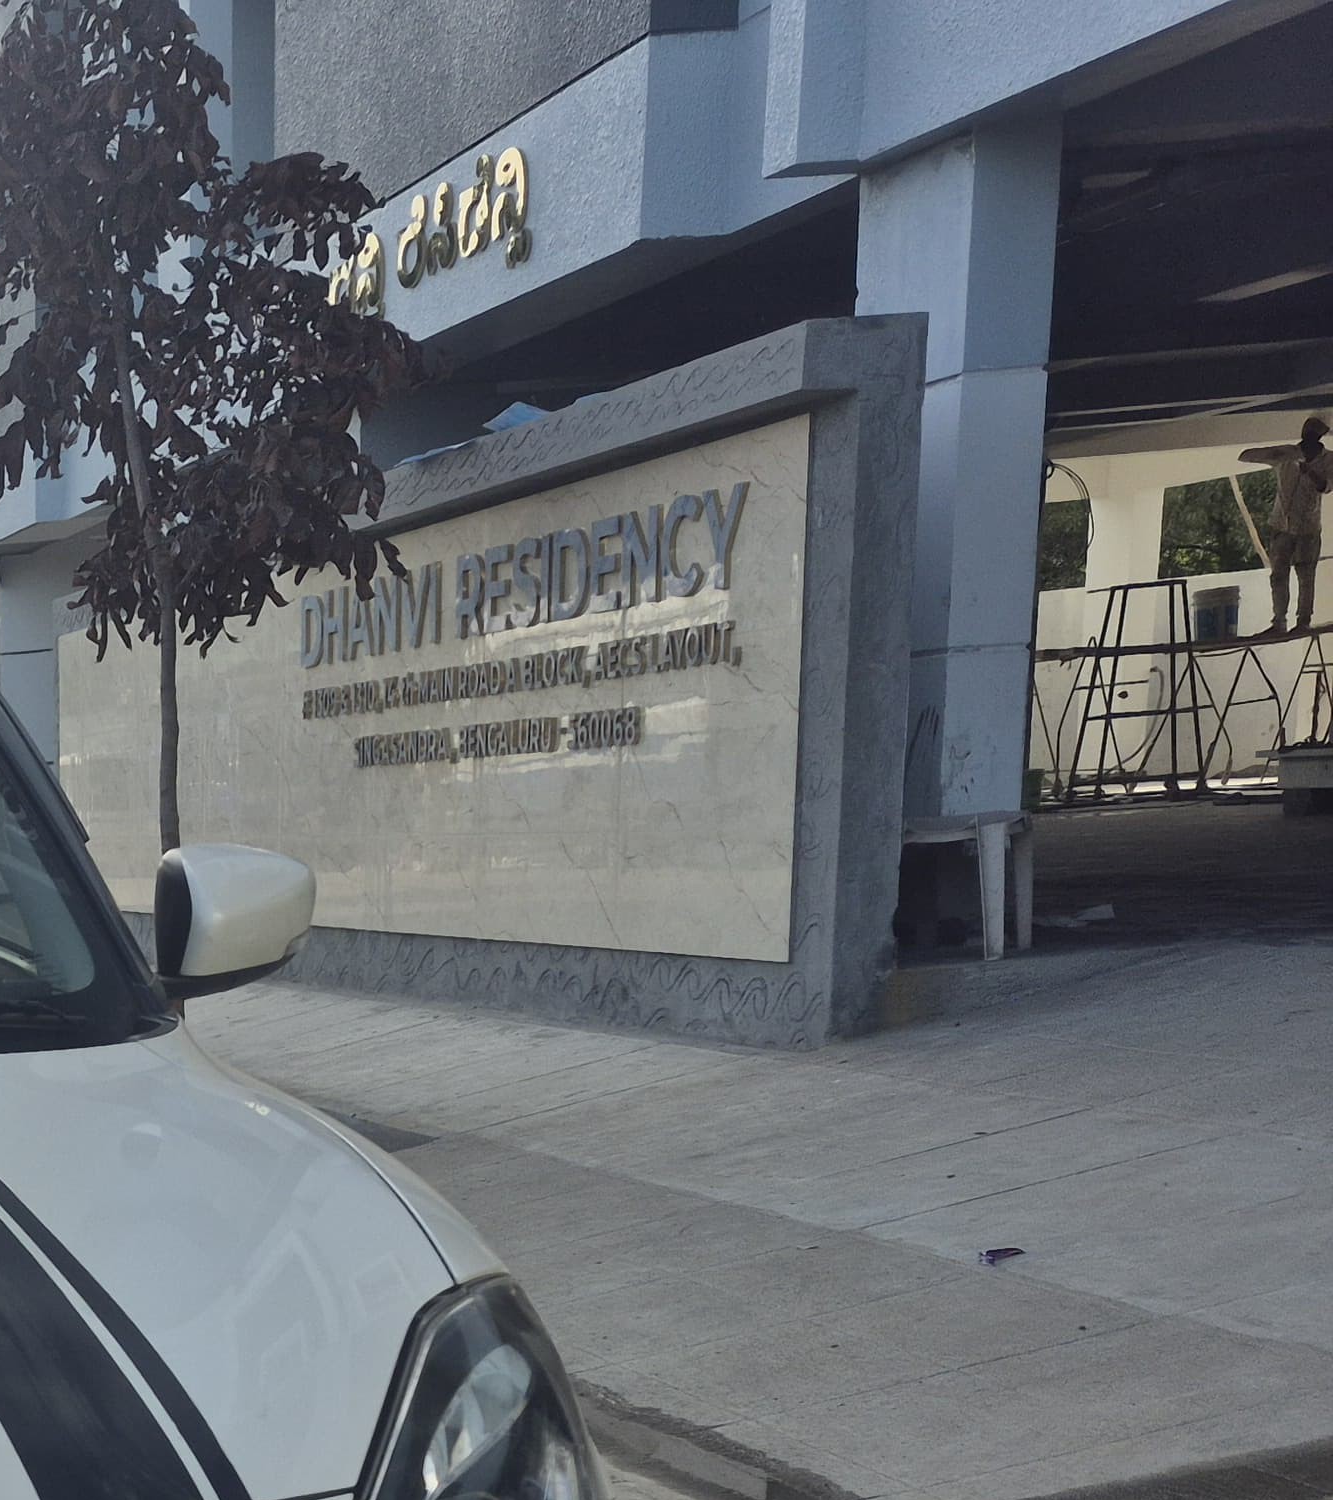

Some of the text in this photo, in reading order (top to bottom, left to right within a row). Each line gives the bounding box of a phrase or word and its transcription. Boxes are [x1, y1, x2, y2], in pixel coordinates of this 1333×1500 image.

[300, 481, 750, 669] DHANVI RESIDENCY
[419, 666, 458, 704] MAIN
[457, 660, 505, 700] ROAD
[505, 657, 521, 692] A
[522, 646, 591, 690] BLOCK,
[594, 634, 648, 682] AECS
[646, 620, 742, 673] LAYOUT,
[459, 717, 559, 759] BENGALURU
